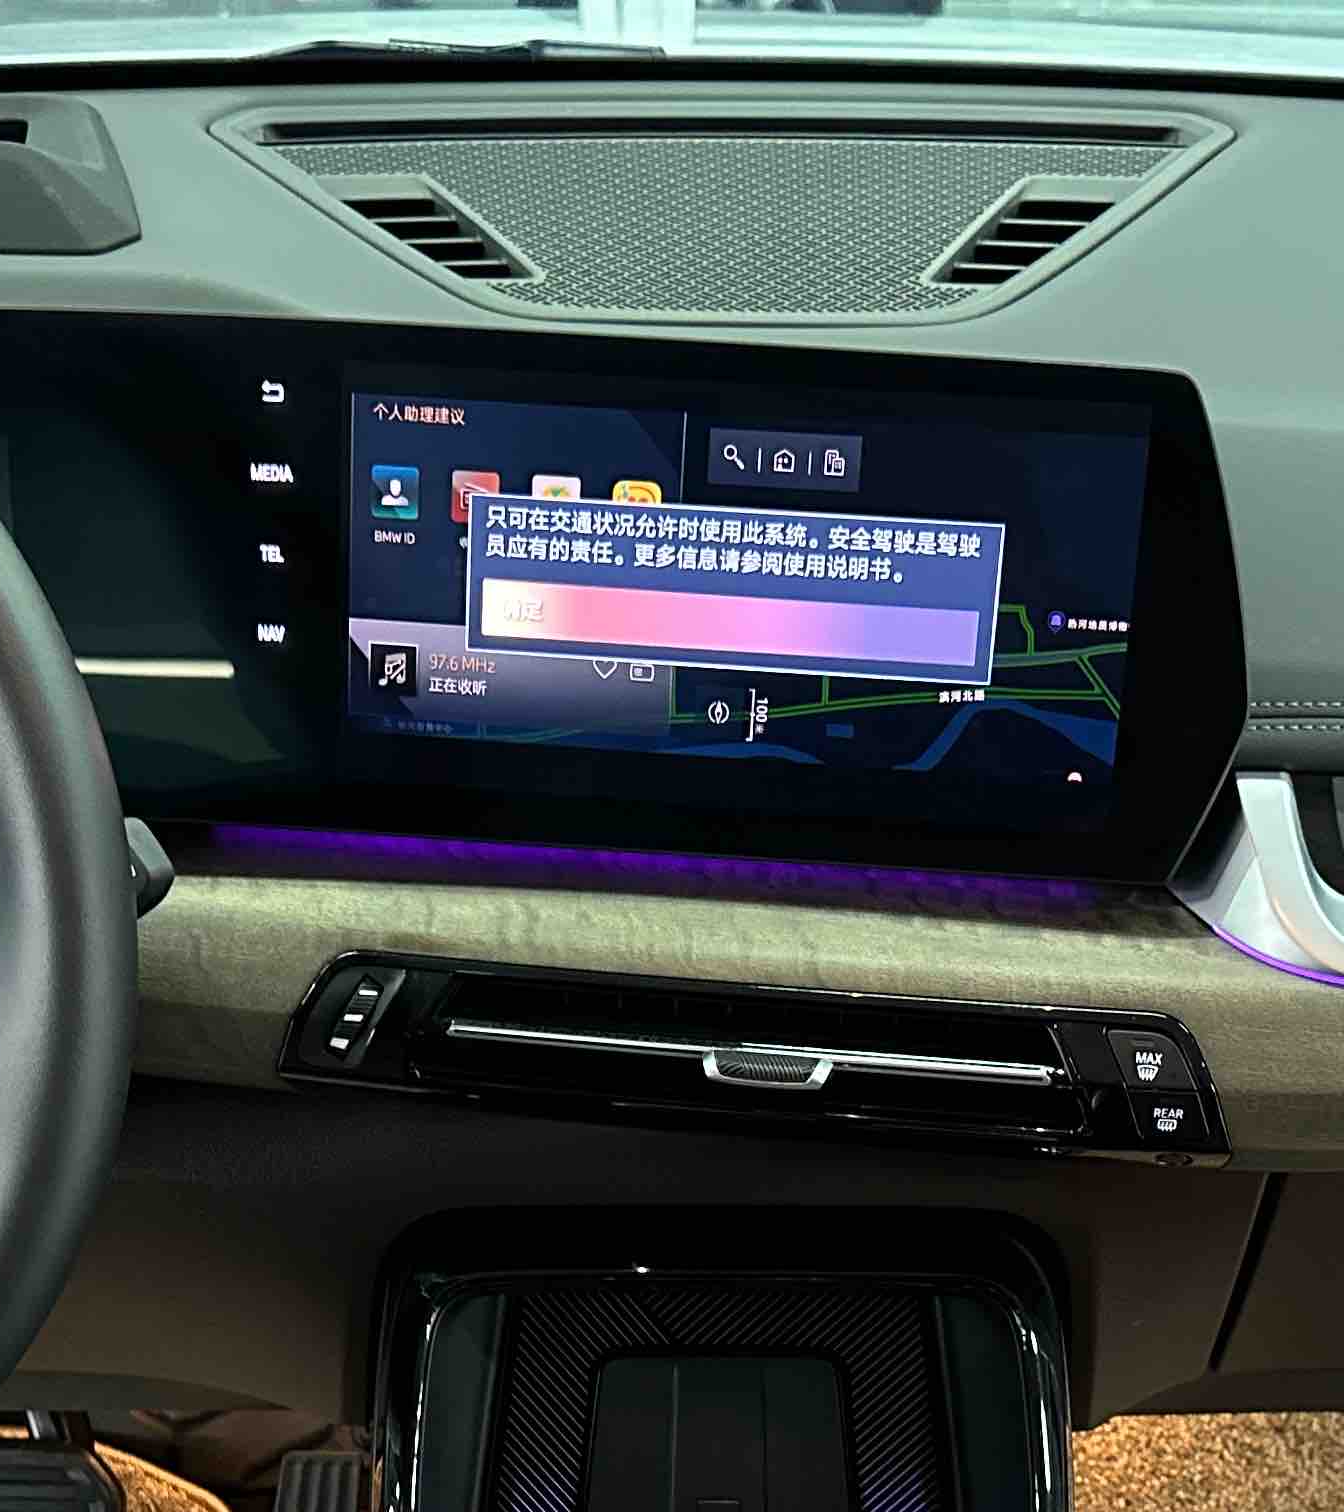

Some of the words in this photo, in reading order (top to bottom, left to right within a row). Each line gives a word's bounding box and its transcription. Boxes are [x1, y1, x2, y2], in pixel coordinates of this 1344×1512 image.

[373, 402, 465, 427] 个人助理建议
[250, 462, 294, 483] MEDIA
[374, 531, 401, 545] BMW
[403, 533, 416, 546] ID
[485, 504, 981, 559] 只可在交通状况允许时使用此系统。安全驾驶是驾驶
[259, 544, 285, 563] TEL
[485, 533, 904, 584] 员应有的责任。更多信息请参阅使用说明书。
[257, 623, 286, 643] NAV
[429, 653, 458, 673] 97.6
[462, 655, 497, 674] MHz
[1136, 1051, 1163, 1066] MAX
[1153, 1107, 1184, 1120] REAR
